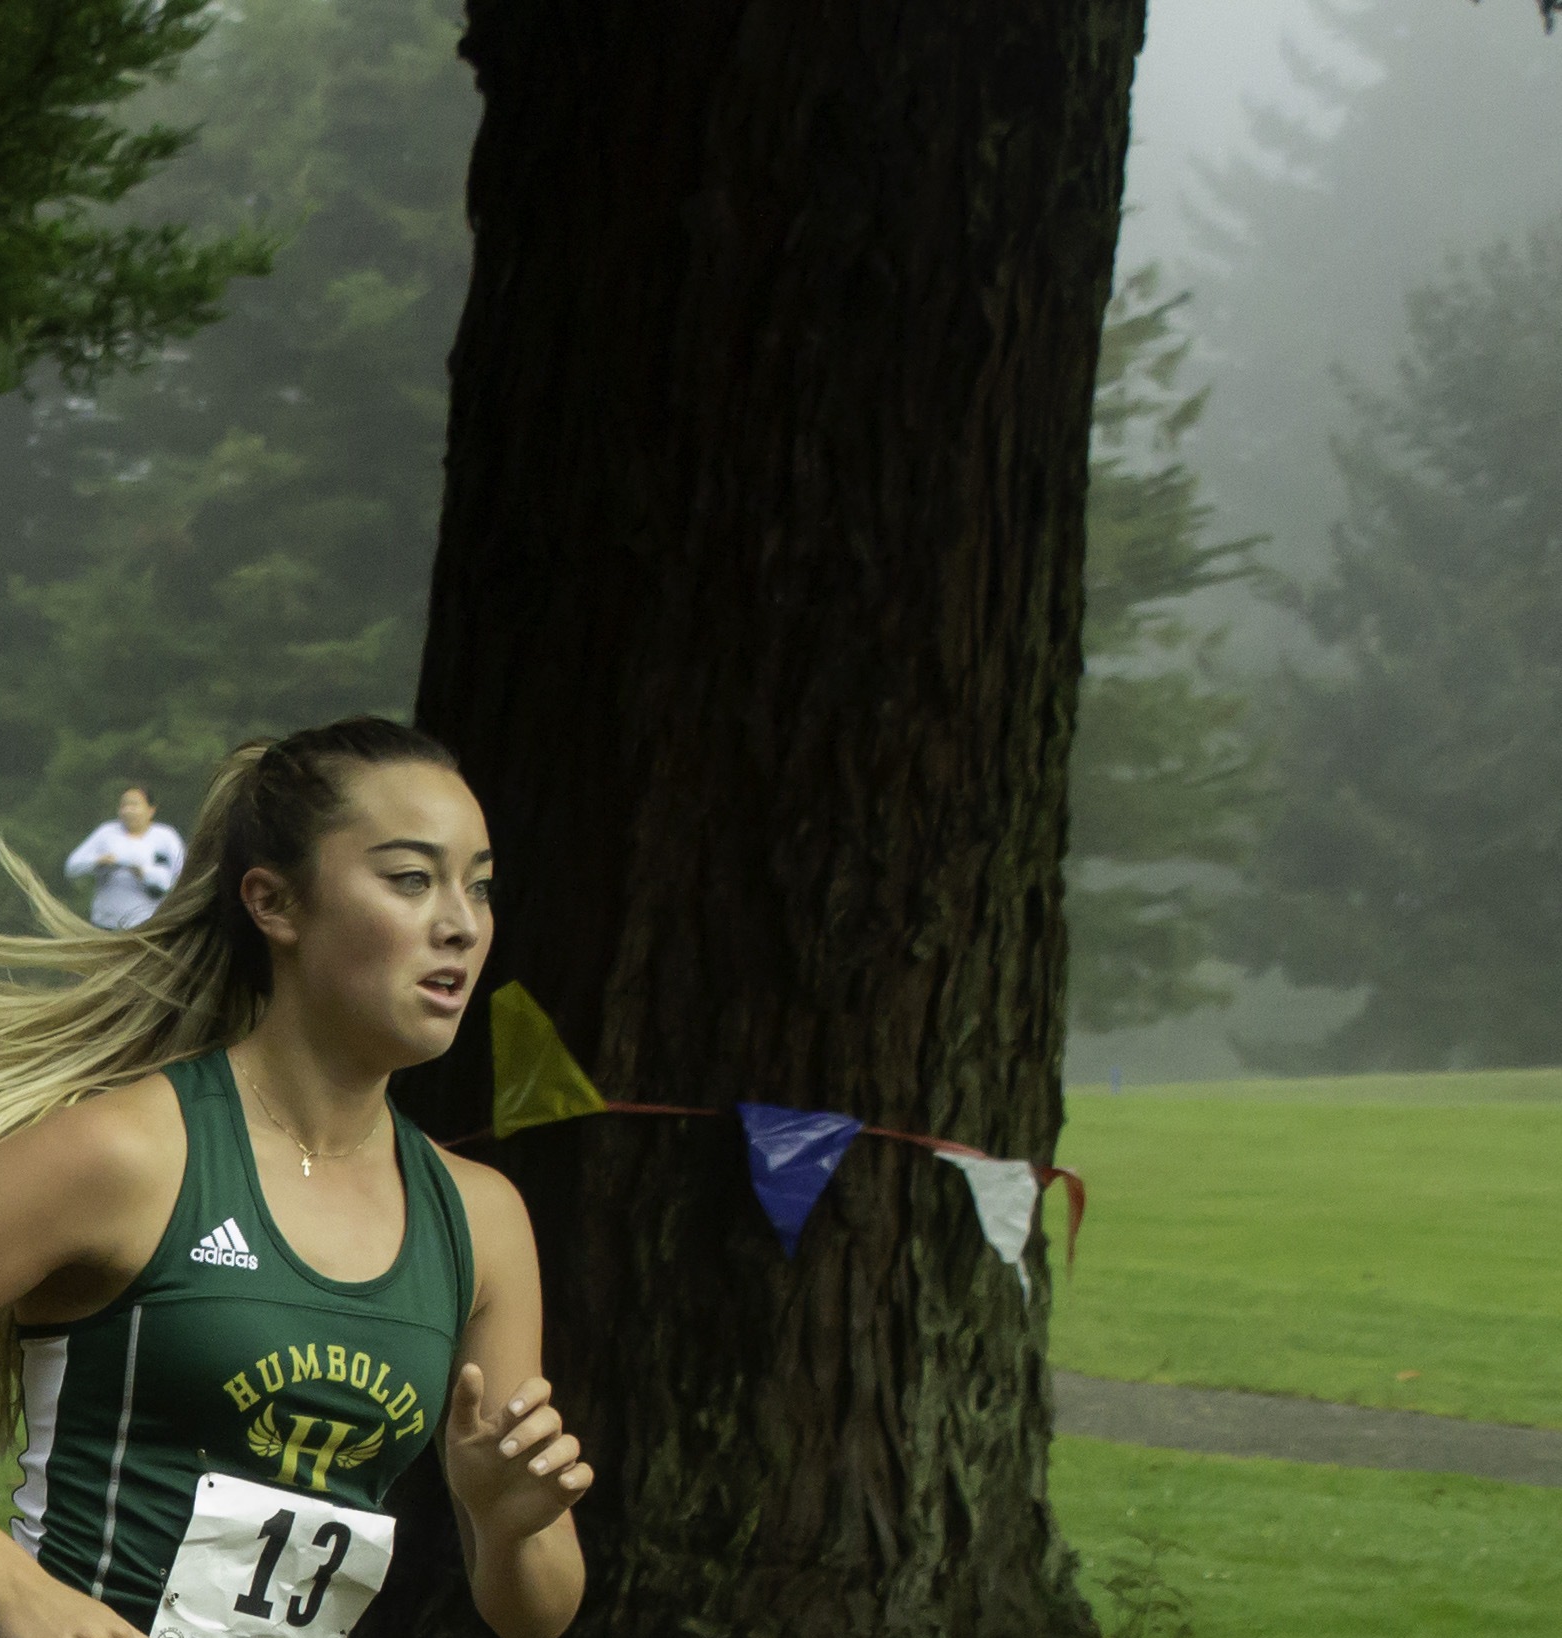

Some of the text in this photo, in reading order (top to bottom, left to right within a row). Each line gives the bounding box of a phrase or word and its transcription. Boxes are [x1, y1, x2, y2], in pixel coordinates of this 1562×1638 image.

[190, 1245, 258, 1271] adidas
[222, 1343, 425, 1441] HUMBOLDT
[267, 1413, 360, 1494] H
[233, 1508, 353, 1628] 13
